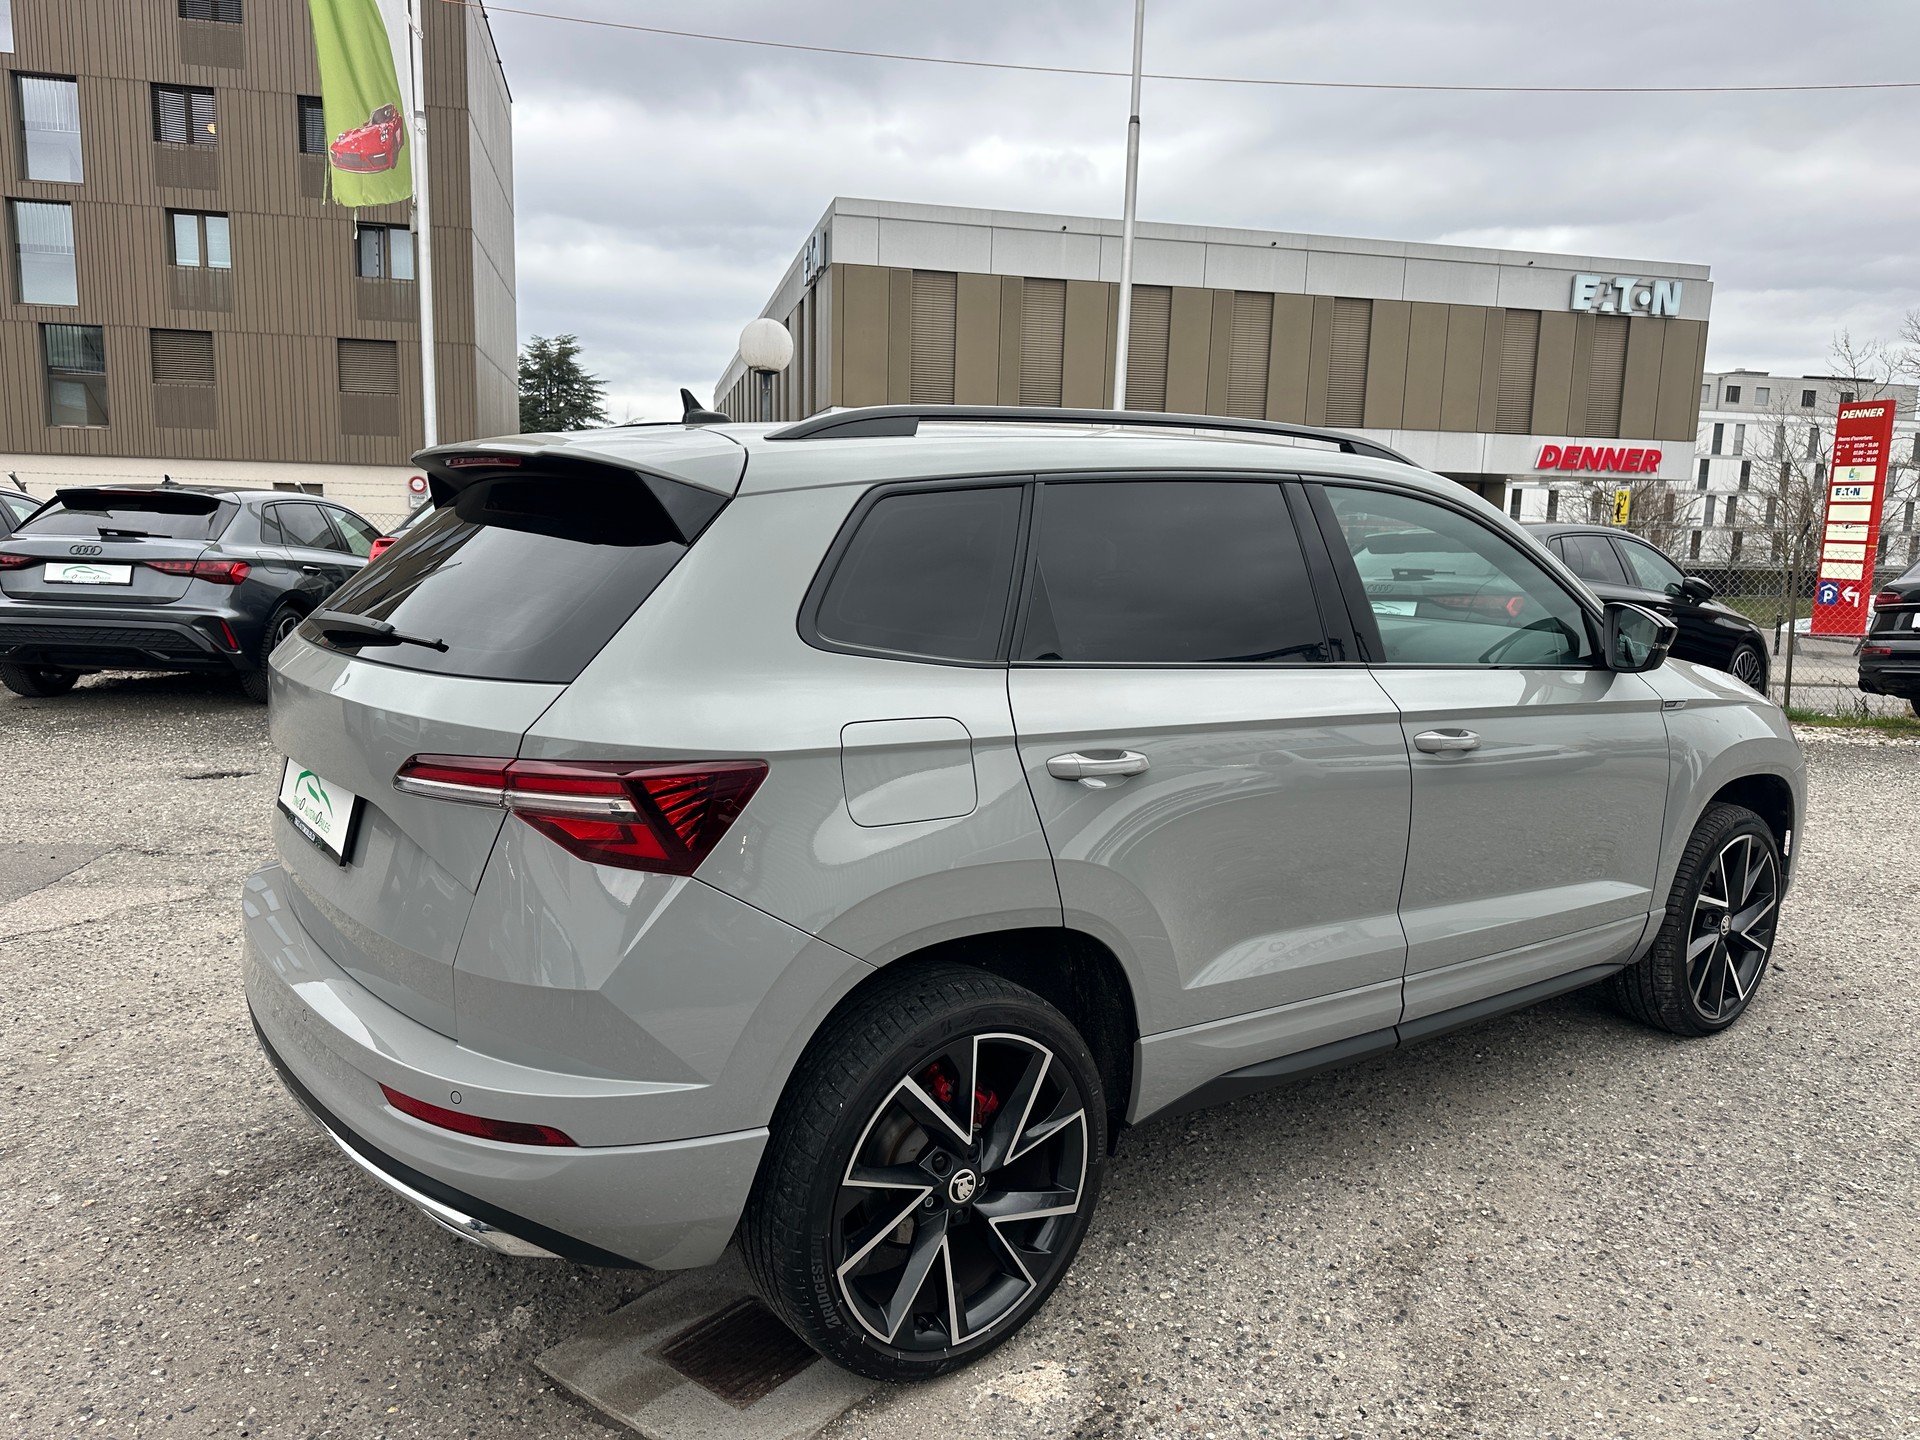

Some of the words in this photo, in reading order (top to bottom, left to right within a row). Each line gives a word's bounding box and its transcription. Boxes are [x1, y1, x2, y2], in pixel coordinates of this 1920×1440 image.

[1572, 273, 1683, 317] EATON
[1840, 408, 1885, 419] DENNER
[1535, 444, 1663, 473] DENNER
[1835, 487, 1861, 496] EATON
[1823, 590, 1834, 602] P
